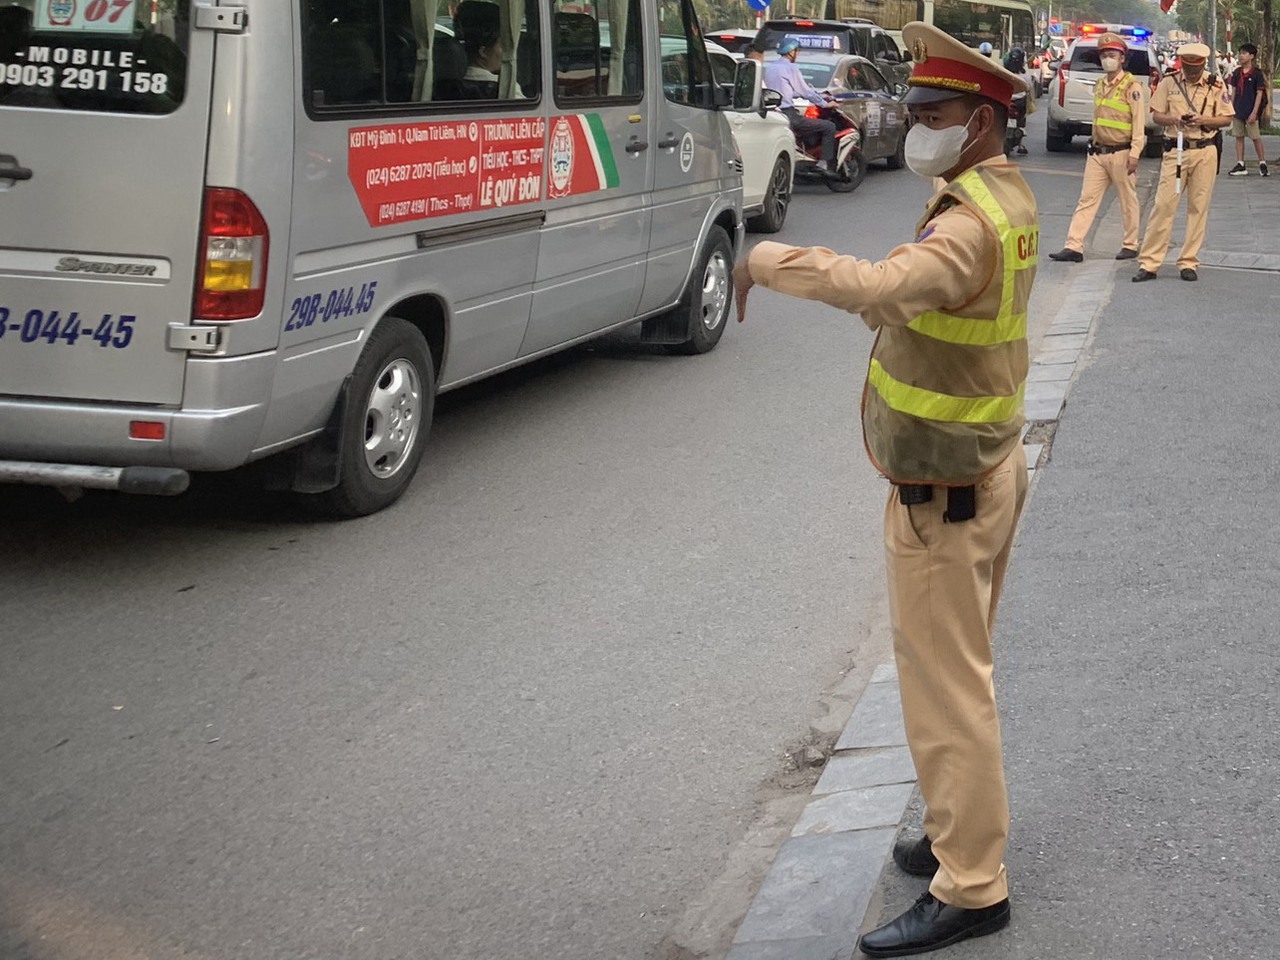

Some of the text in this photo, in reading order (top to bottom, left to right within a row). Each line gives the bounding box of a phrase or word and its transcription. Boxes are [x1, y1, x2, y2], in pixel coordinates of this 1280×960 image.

[60, 67, 108, 91] 291
[119, 70, 168, 95] 158
[367, 130, 379, 149] Mỹ
[379, 128, 397, 145] Đình
[456, 124, 467, 139] HN
[515, 118, 531, 139] LIÊN
[531, 117, 545, 138] CẤP
[366, 166, 389, 189] (024)
[389, 163, 411, 183] 6287
[412, 161, 433, 180] 2079
[481, 171, 541, 208] LÊ QUÝ ĐÔN
[283, 280, 378, 333] 29B-044.45
